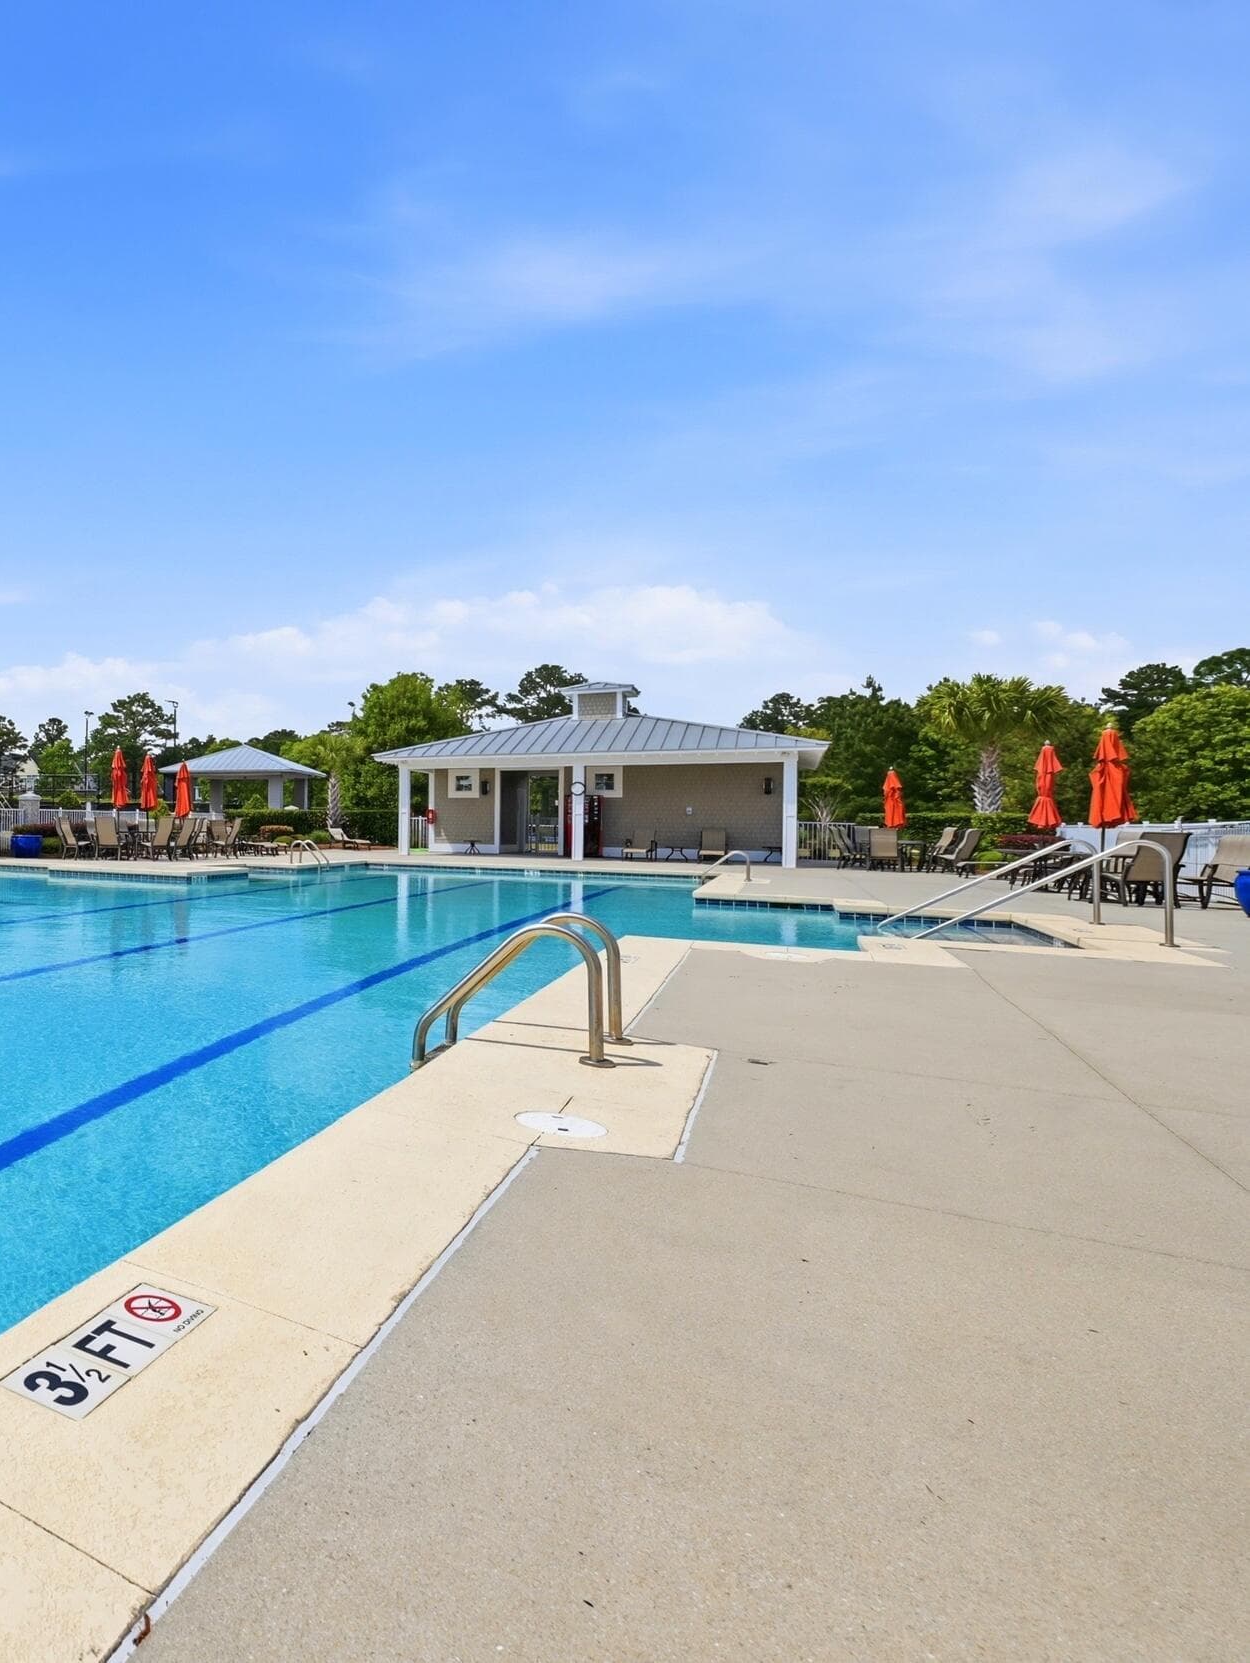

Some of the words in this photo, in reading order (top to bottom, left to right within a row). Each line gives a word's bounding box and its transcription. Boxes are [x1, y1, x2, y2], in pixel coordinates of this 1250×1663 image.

[172, 1324, 186, 1333] NO
[182, 1309, 204, 1326] DIVING
[72, 1319, 156, 1369] FT
